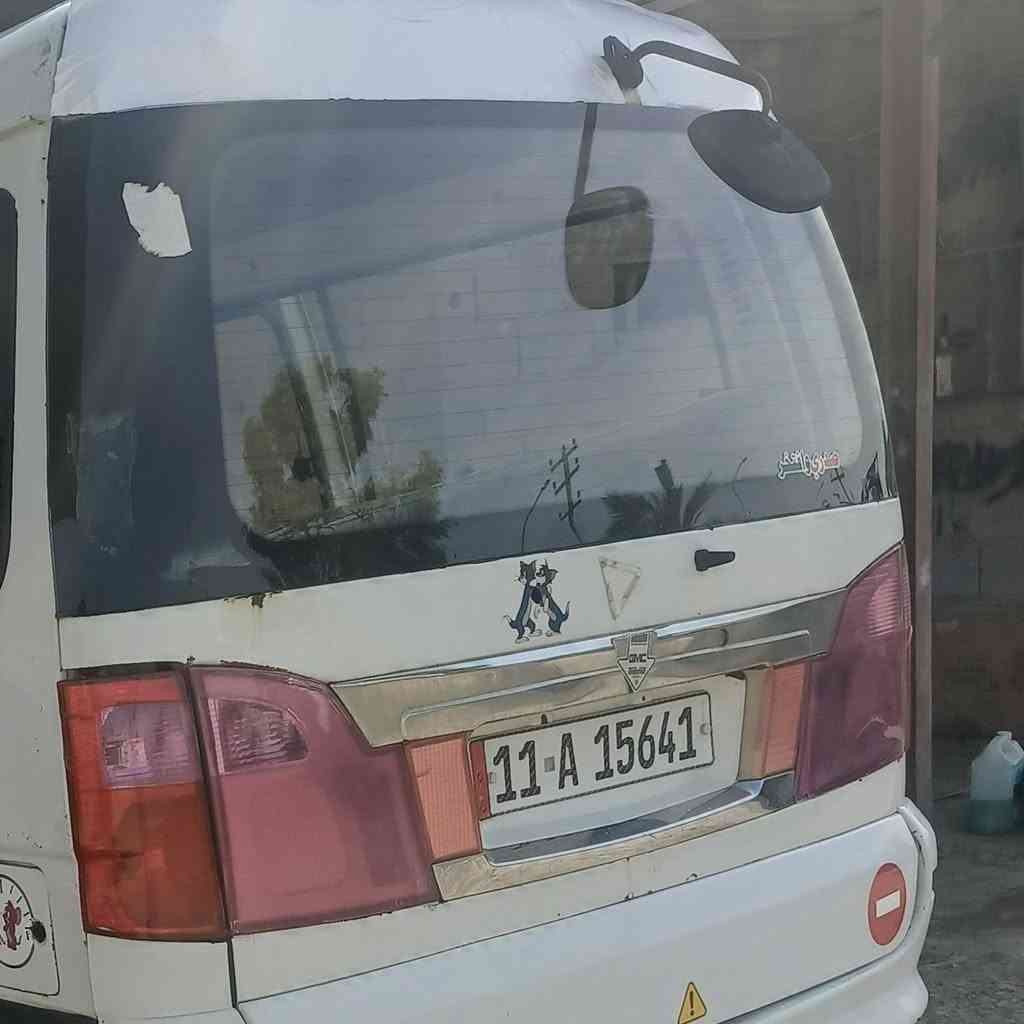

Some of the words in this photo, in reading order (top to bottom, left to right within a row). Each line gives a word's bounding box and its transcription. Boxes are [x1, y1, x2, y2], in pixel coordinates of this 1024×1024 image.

[493, 739, 541, 804] 11
[558, 732, 579, 790] A
[594, 706, 697, 781] 15641
